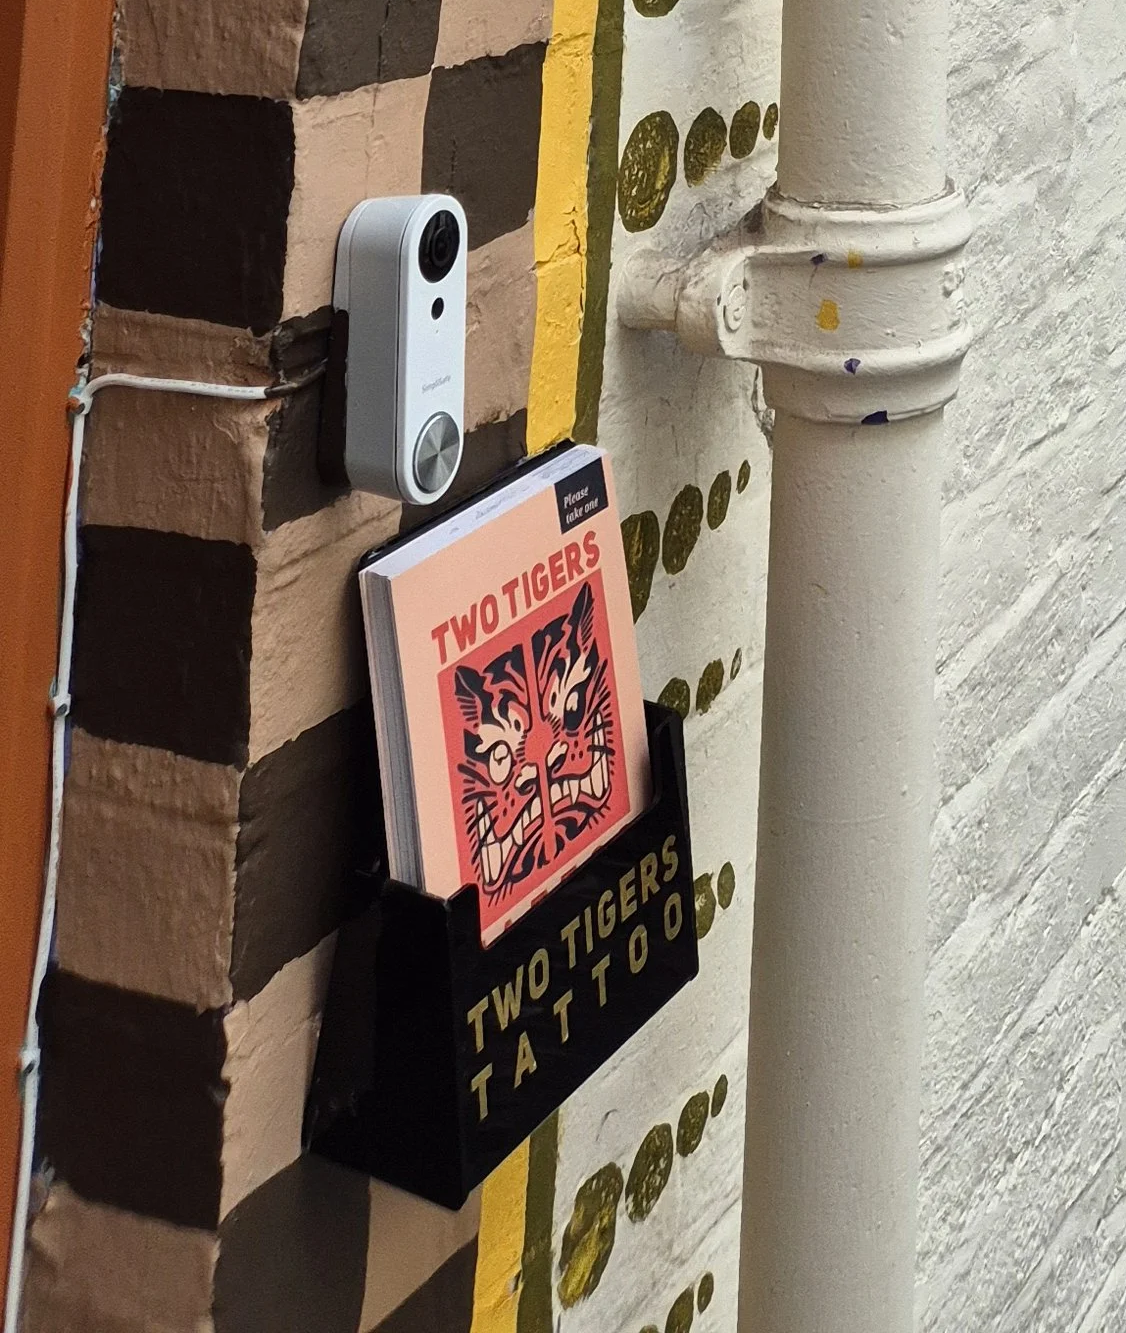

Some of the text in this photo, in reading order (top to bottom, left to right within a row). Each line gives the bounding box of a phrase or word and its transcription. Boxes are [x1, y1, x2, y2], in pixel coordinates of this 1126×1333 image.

[563, 486, 589, 510] Please
[565, 497, 599, 525] take one
[431, 530, 601, 665] TWO TIGERS
[467, 948, 550, 1054] TWO
[560, 834, 679, 970] TIGERS
[470, 892, 683, 1123] TATTOO
